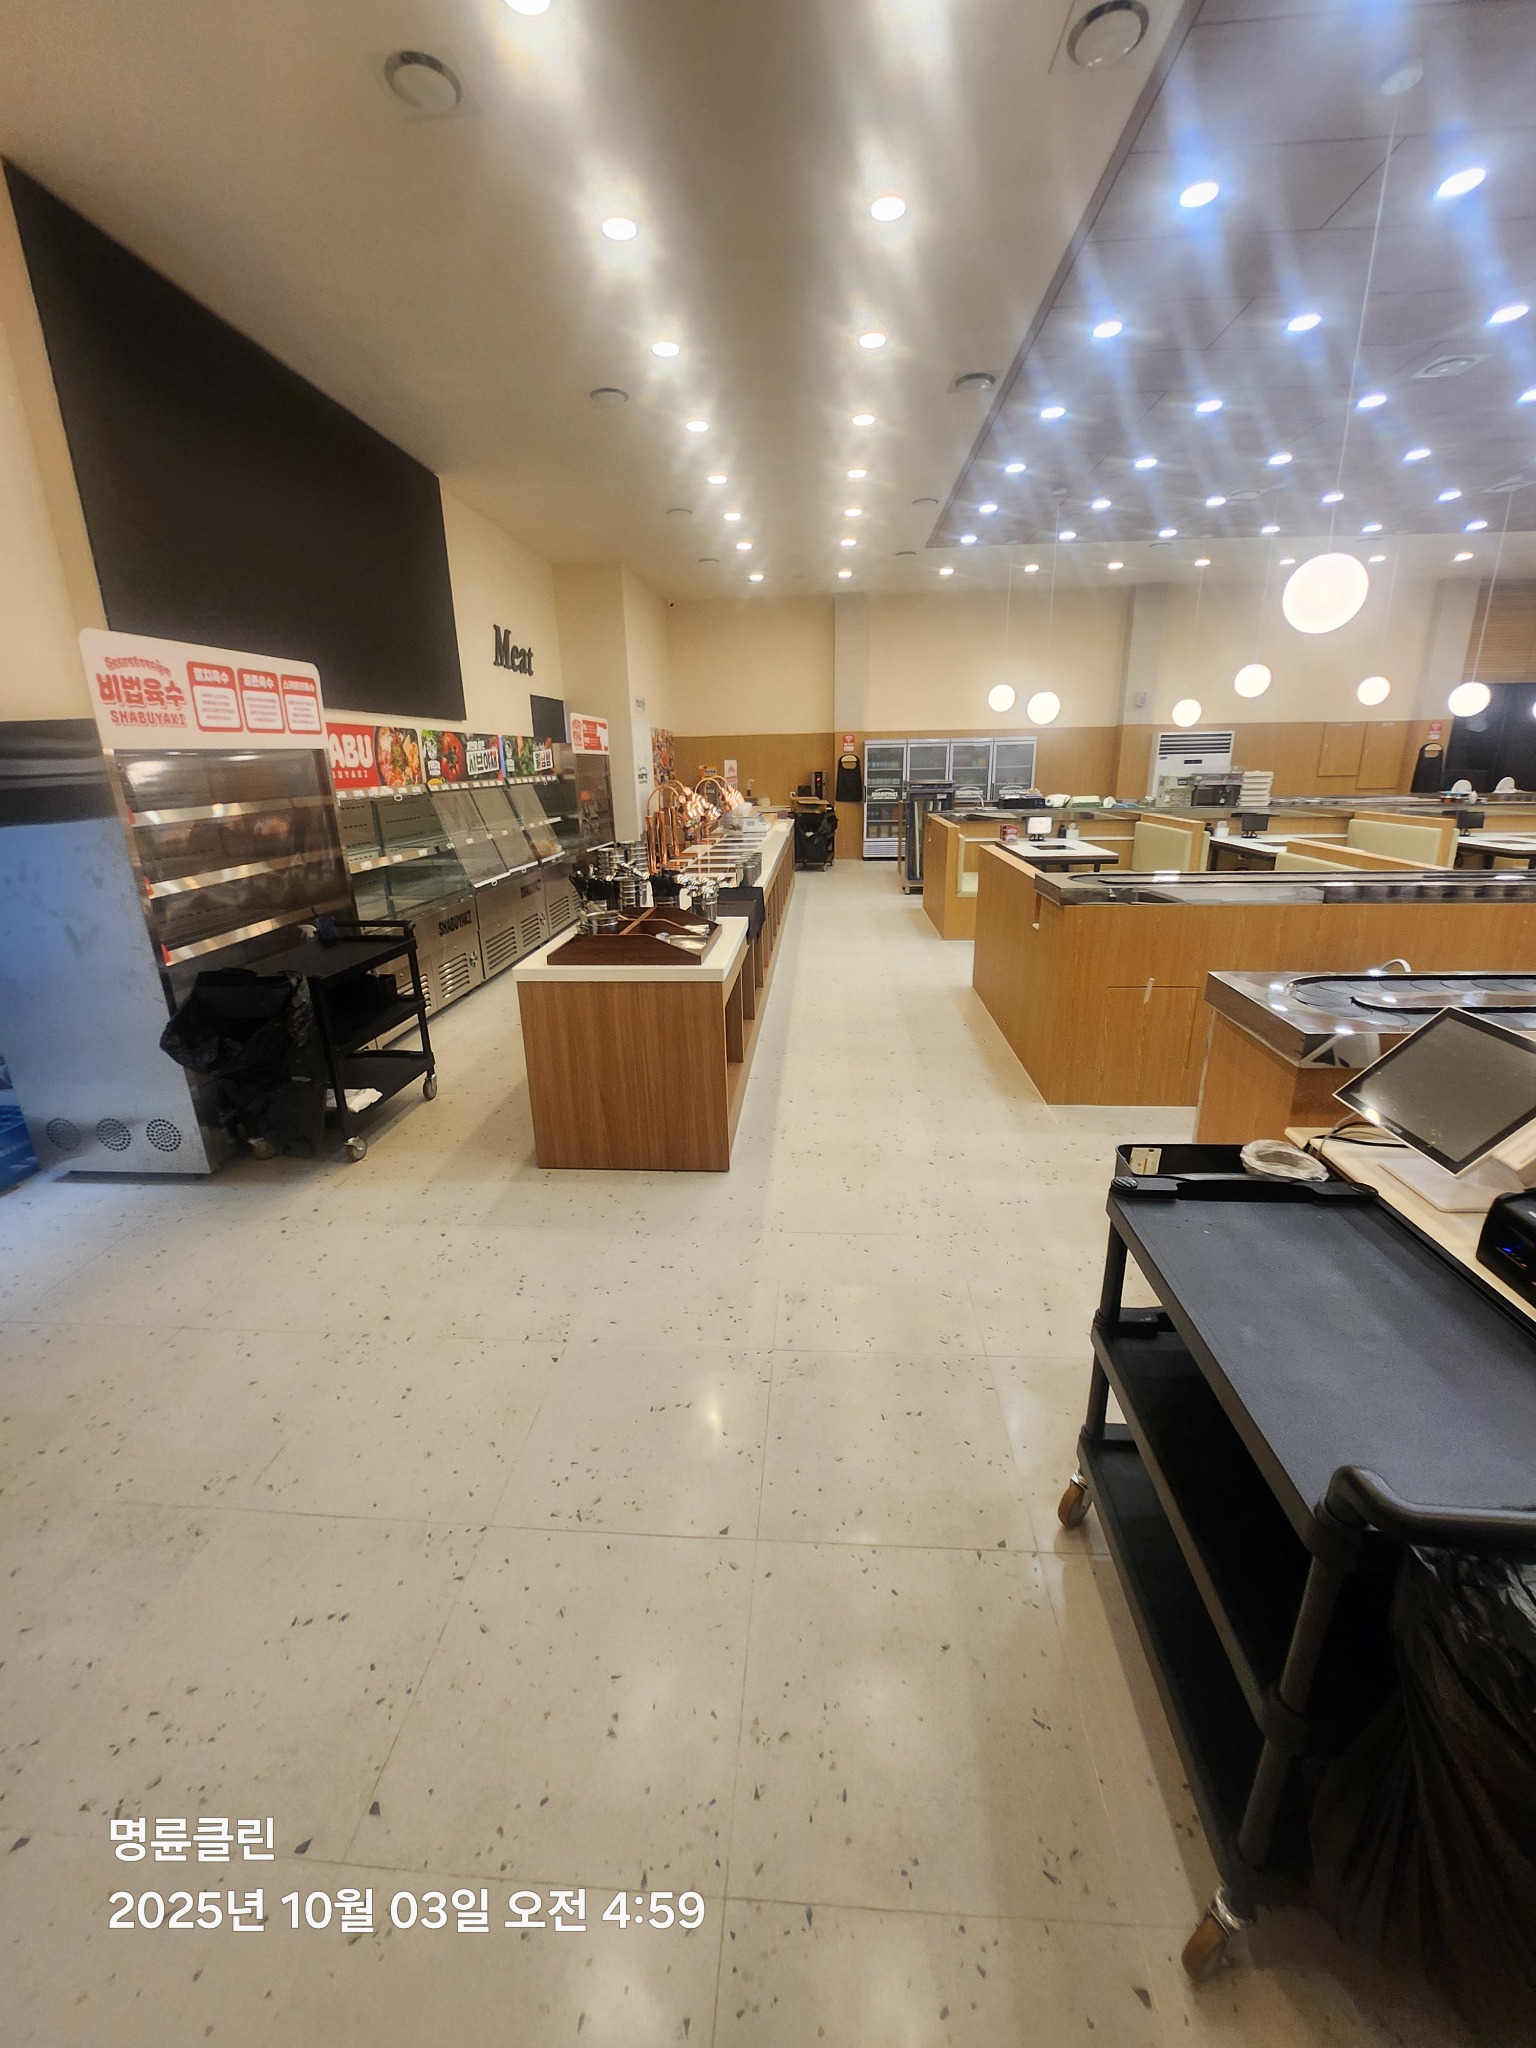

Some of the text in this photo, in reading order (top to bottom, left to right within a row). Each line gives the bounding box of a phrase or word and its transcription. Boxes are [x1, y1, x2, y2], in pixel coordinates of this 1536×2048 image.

[493, 624, 535, 677] Meat
[96, 673, 185, 709] 비법육수
[110, 709, 186, 727] SHABUYAKI
[328, 733, 374, 769] ABU
